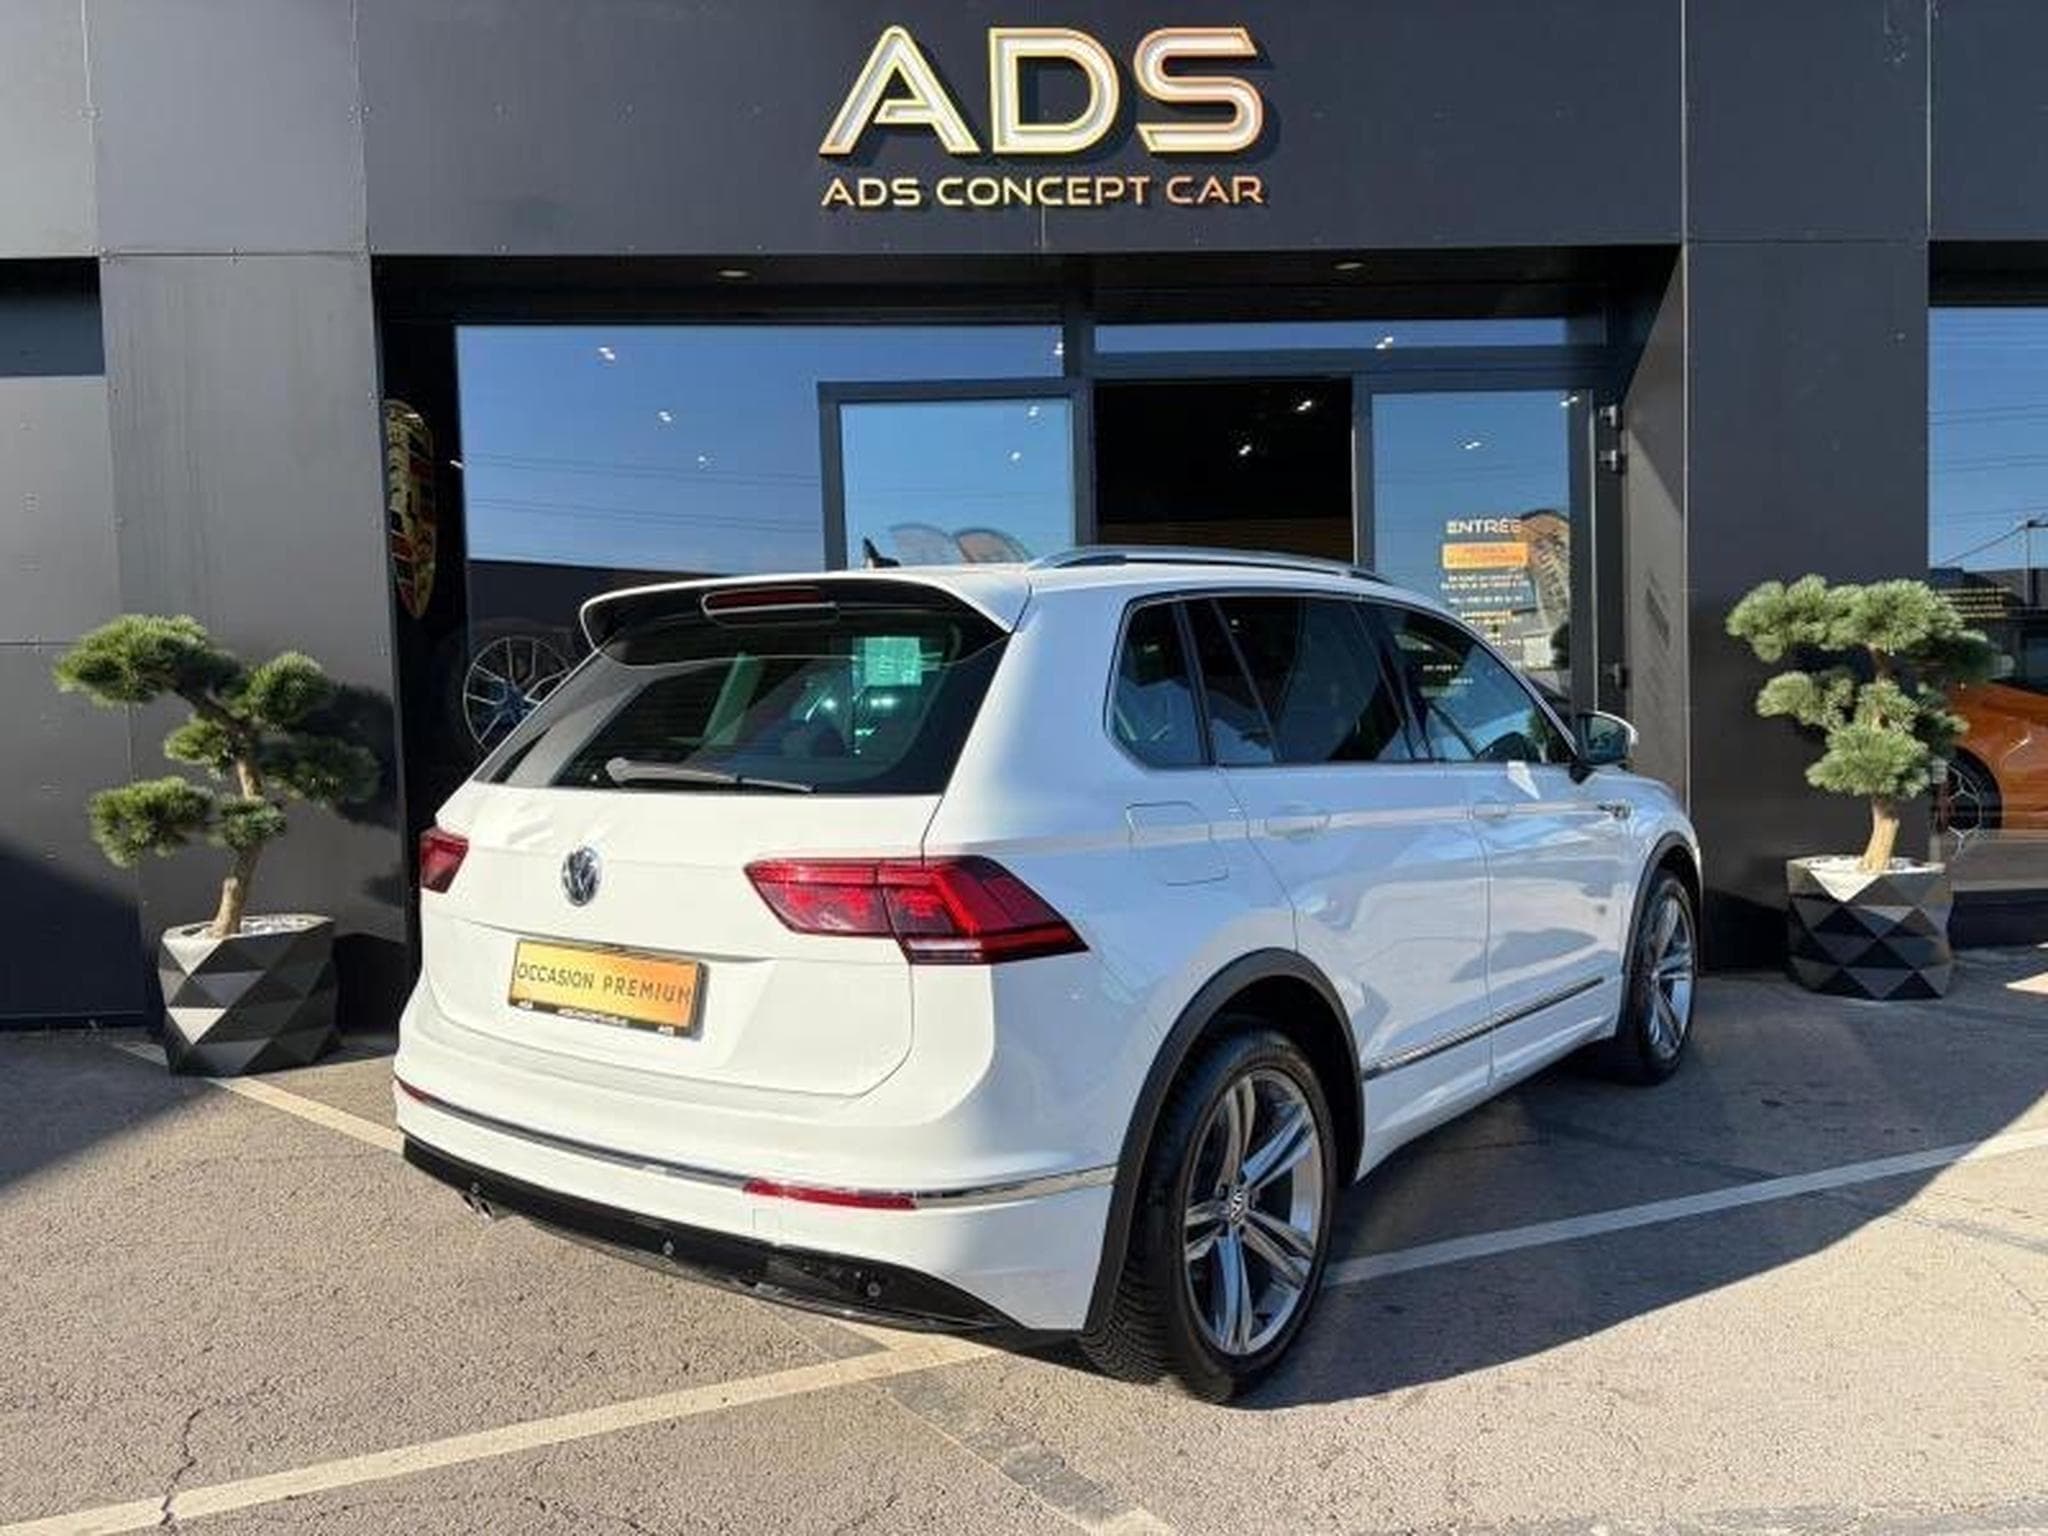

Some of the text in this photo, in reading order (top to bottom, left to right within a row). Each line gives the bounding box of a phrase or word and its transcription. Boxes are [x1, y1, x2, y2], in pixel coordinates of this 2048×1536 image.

[818, 25, 1264, 155] ADS
[822, 175, 1265, 207] ADS CONCEPT CAR
[516, 961, 692, 1005] OCCASION PREMIUM
